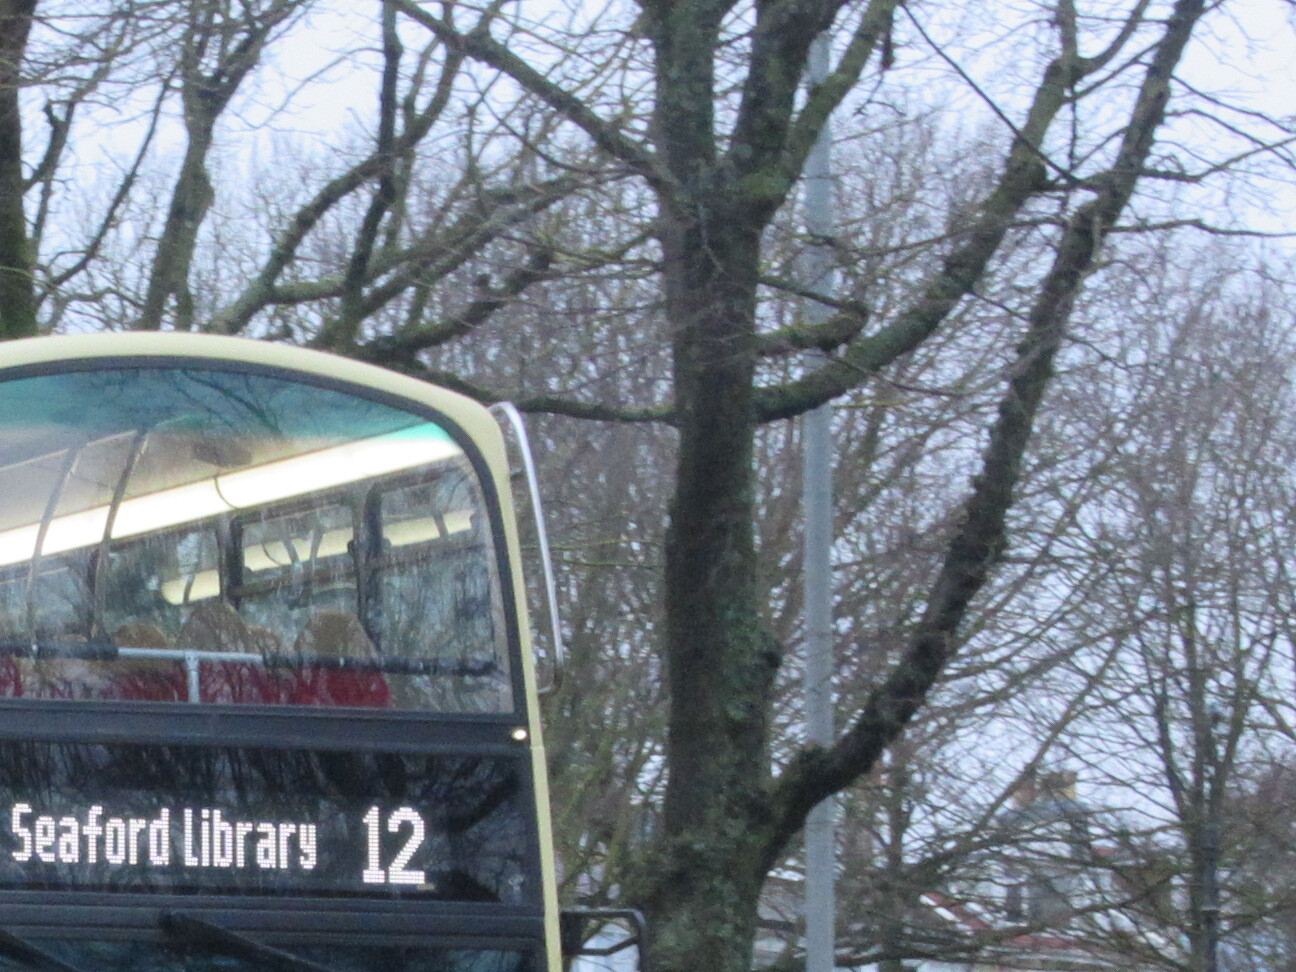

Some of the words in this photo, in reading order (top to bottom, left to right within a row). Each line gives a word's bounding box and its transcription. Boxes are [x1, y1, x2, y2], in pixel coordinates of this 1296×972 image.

[11, 803, 169, 865] Seaford
[184, 808, 317, 869] Library
[362, 805, 426, 885] 12
